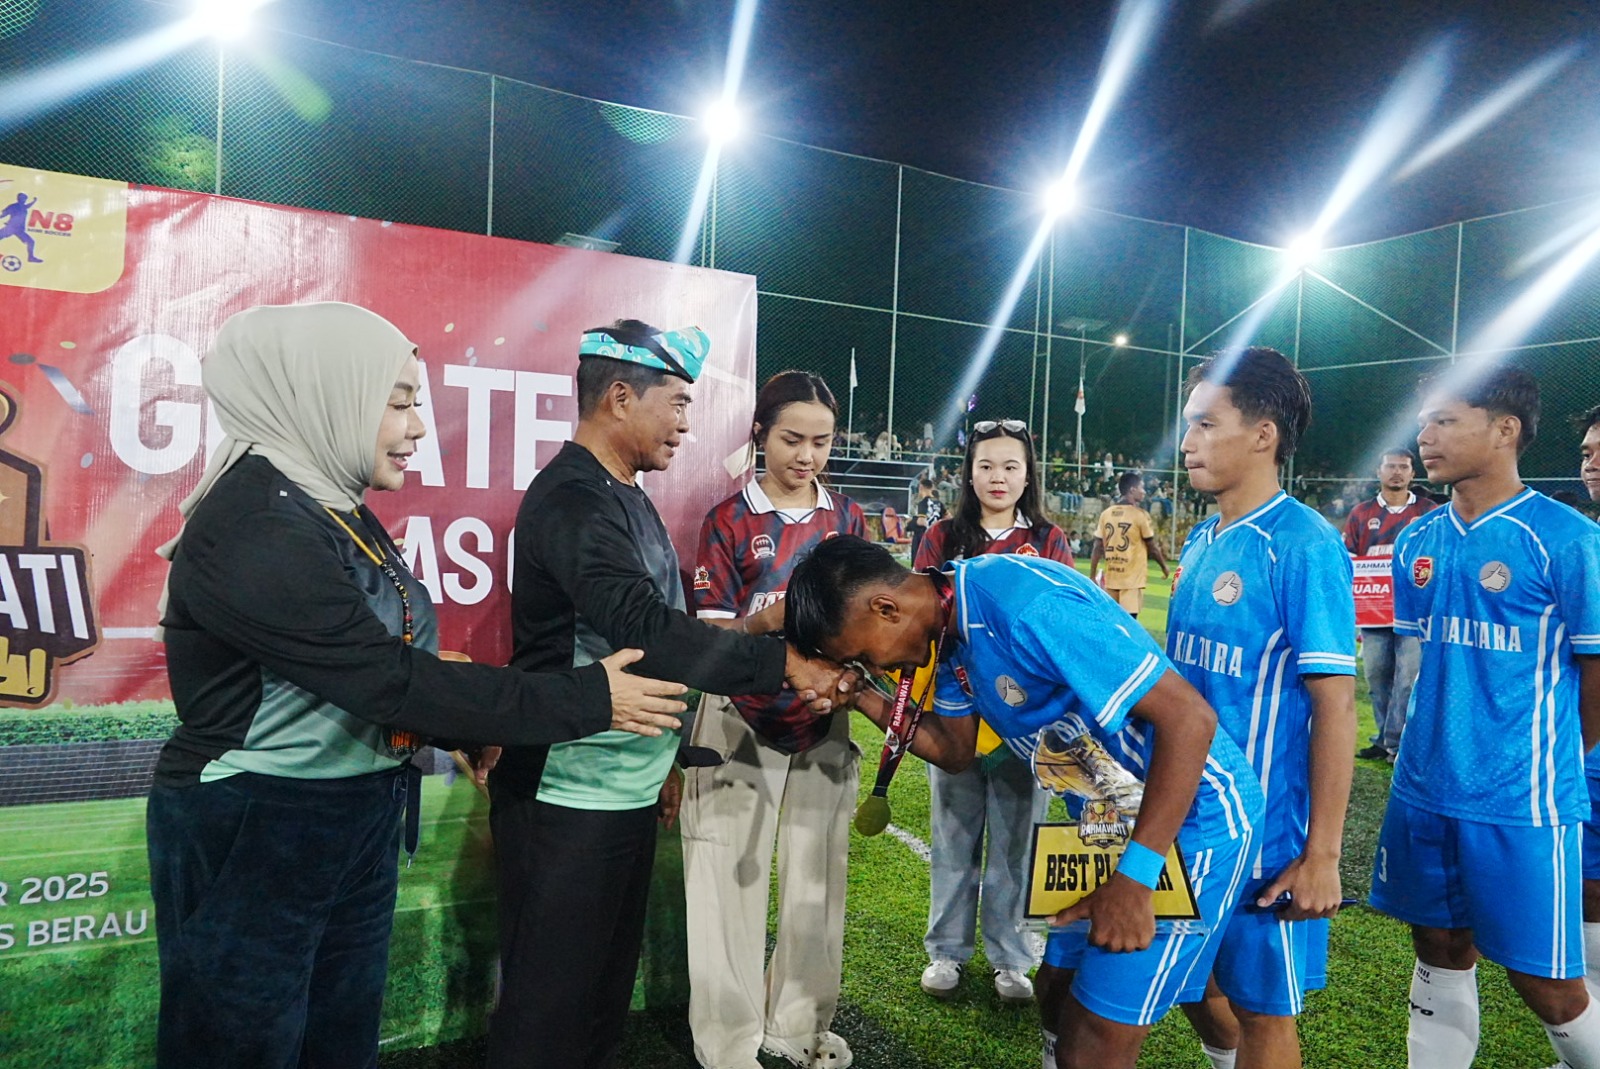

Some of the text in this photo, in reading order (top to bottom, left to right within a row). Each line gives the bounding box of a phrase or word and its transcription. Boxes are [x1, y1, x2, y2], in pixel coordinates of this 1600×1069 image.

[28, 209, 74, 231] N8
[1105, 522, 1132, 552] 23
[1353, 584, 1390, 594] UARA
[1081, 823, 1126, 837] RAHMAWATI
[1044, 853, 1090, 892] BEST
[19, 871, 109, 905] 2025
[27, 909, 147, 947] BERAU
